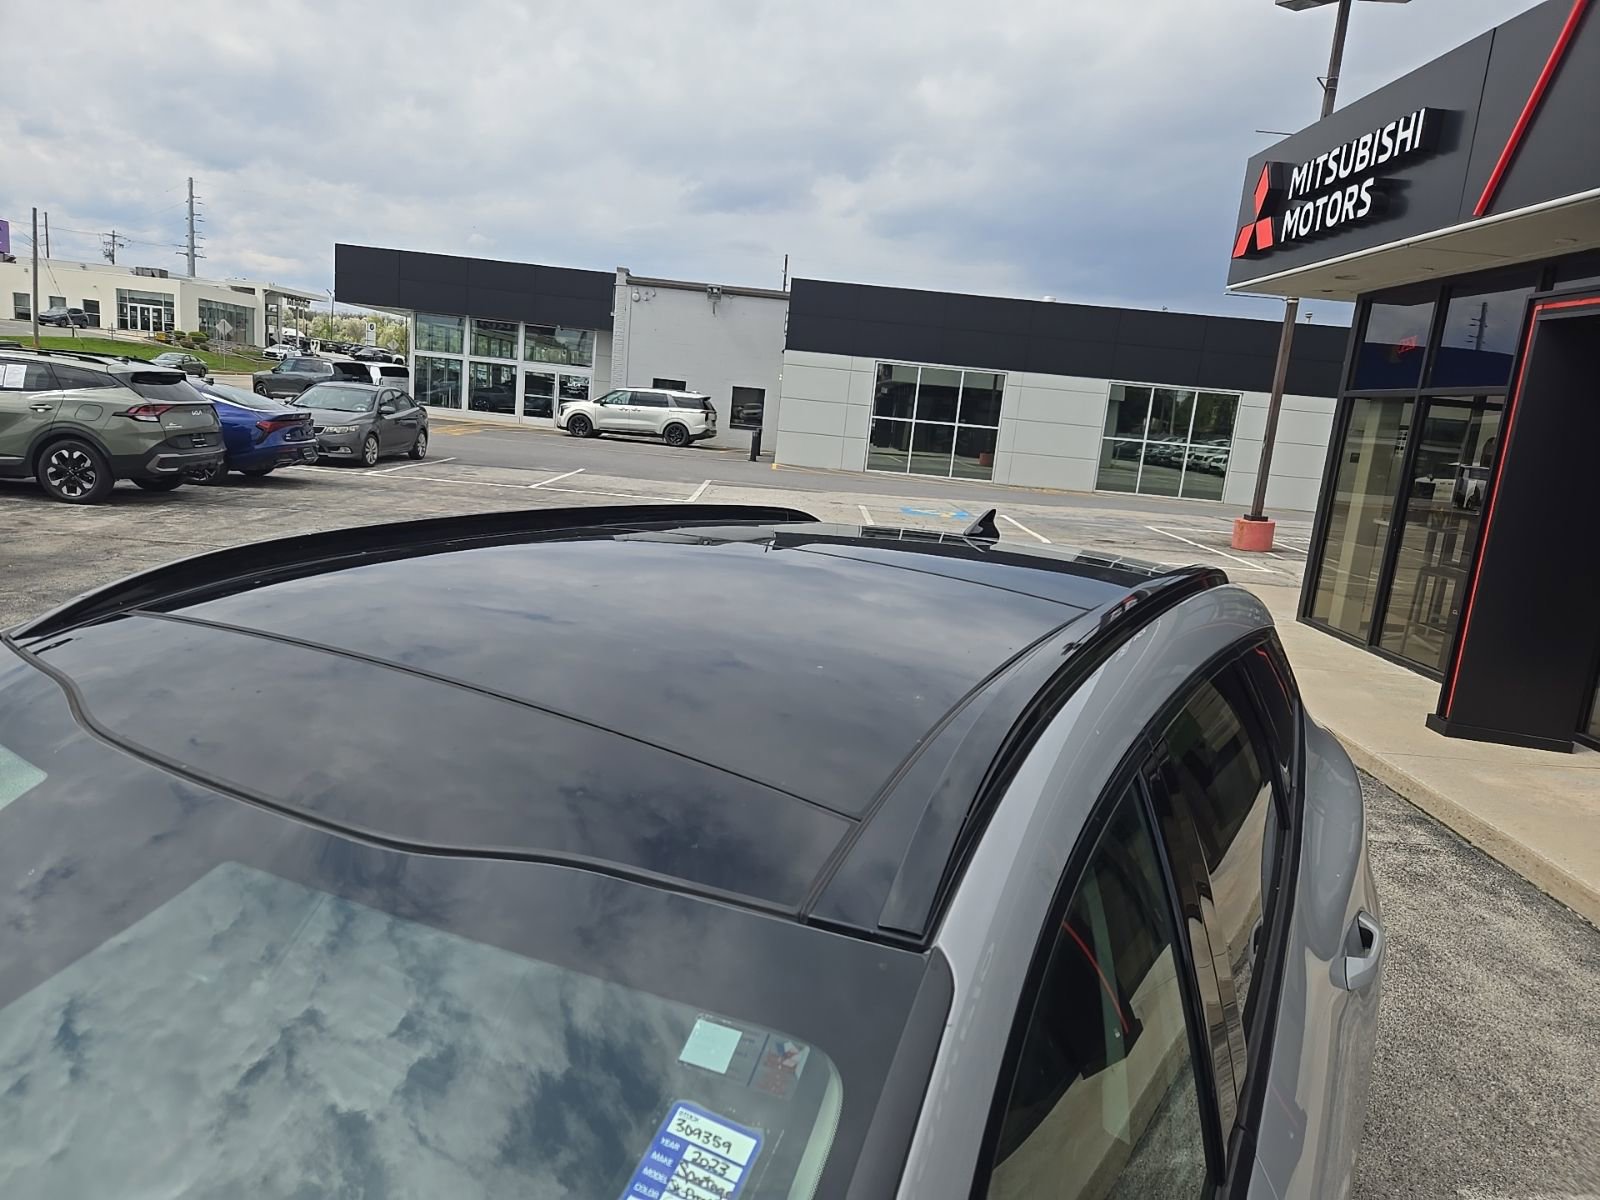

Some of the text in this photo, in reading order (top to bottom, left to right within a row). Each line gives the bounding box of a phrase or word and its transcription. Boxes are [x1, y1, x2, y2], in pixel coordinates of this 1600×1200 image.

[1288, 107, 1426, 200] MITSUBISHI
[1281, 177, 1375, 242] MOTORS
[660, 1137, 681, 1152] YEAR
[650, 1151, 675, 1168] MAKE
[690, 1150, 730, 1177] 2023
[642, 1166, 669, 1186] MODEL
[632, 1182, 660, 1200] COLOR
